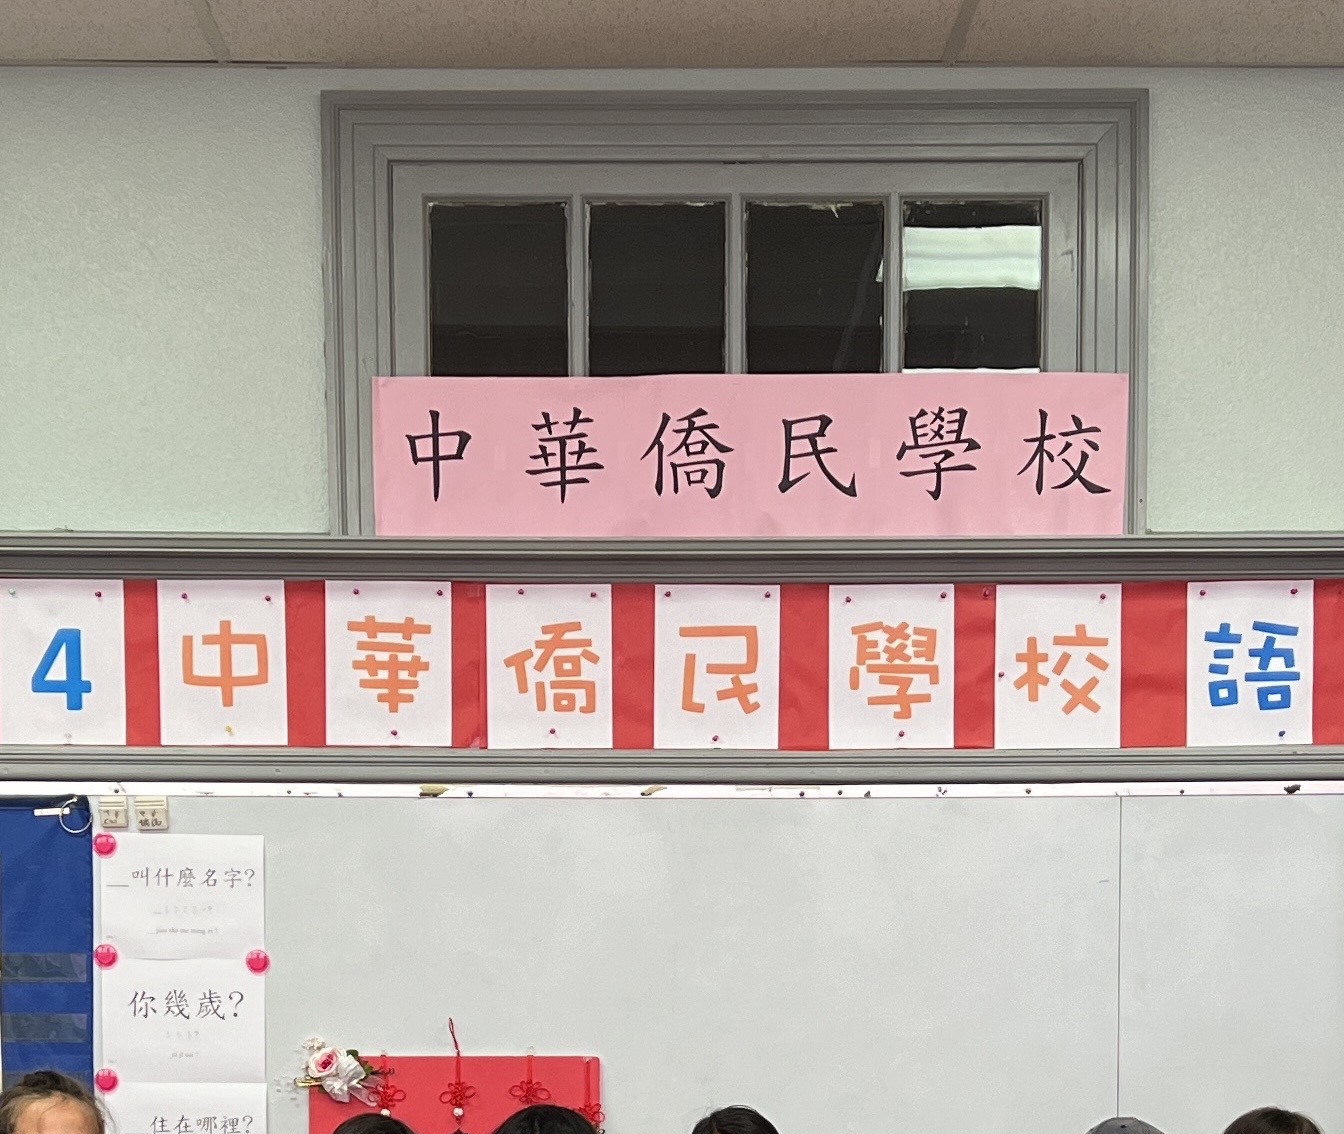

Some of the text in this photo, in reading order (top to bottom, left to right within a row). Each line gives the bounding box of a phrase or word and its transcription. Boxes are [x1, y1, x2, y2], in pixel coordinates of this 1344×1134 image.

[405, 407, 1112, 505] 中華僑民學校
[128, 988, 244, 1021] 你幾歲?
